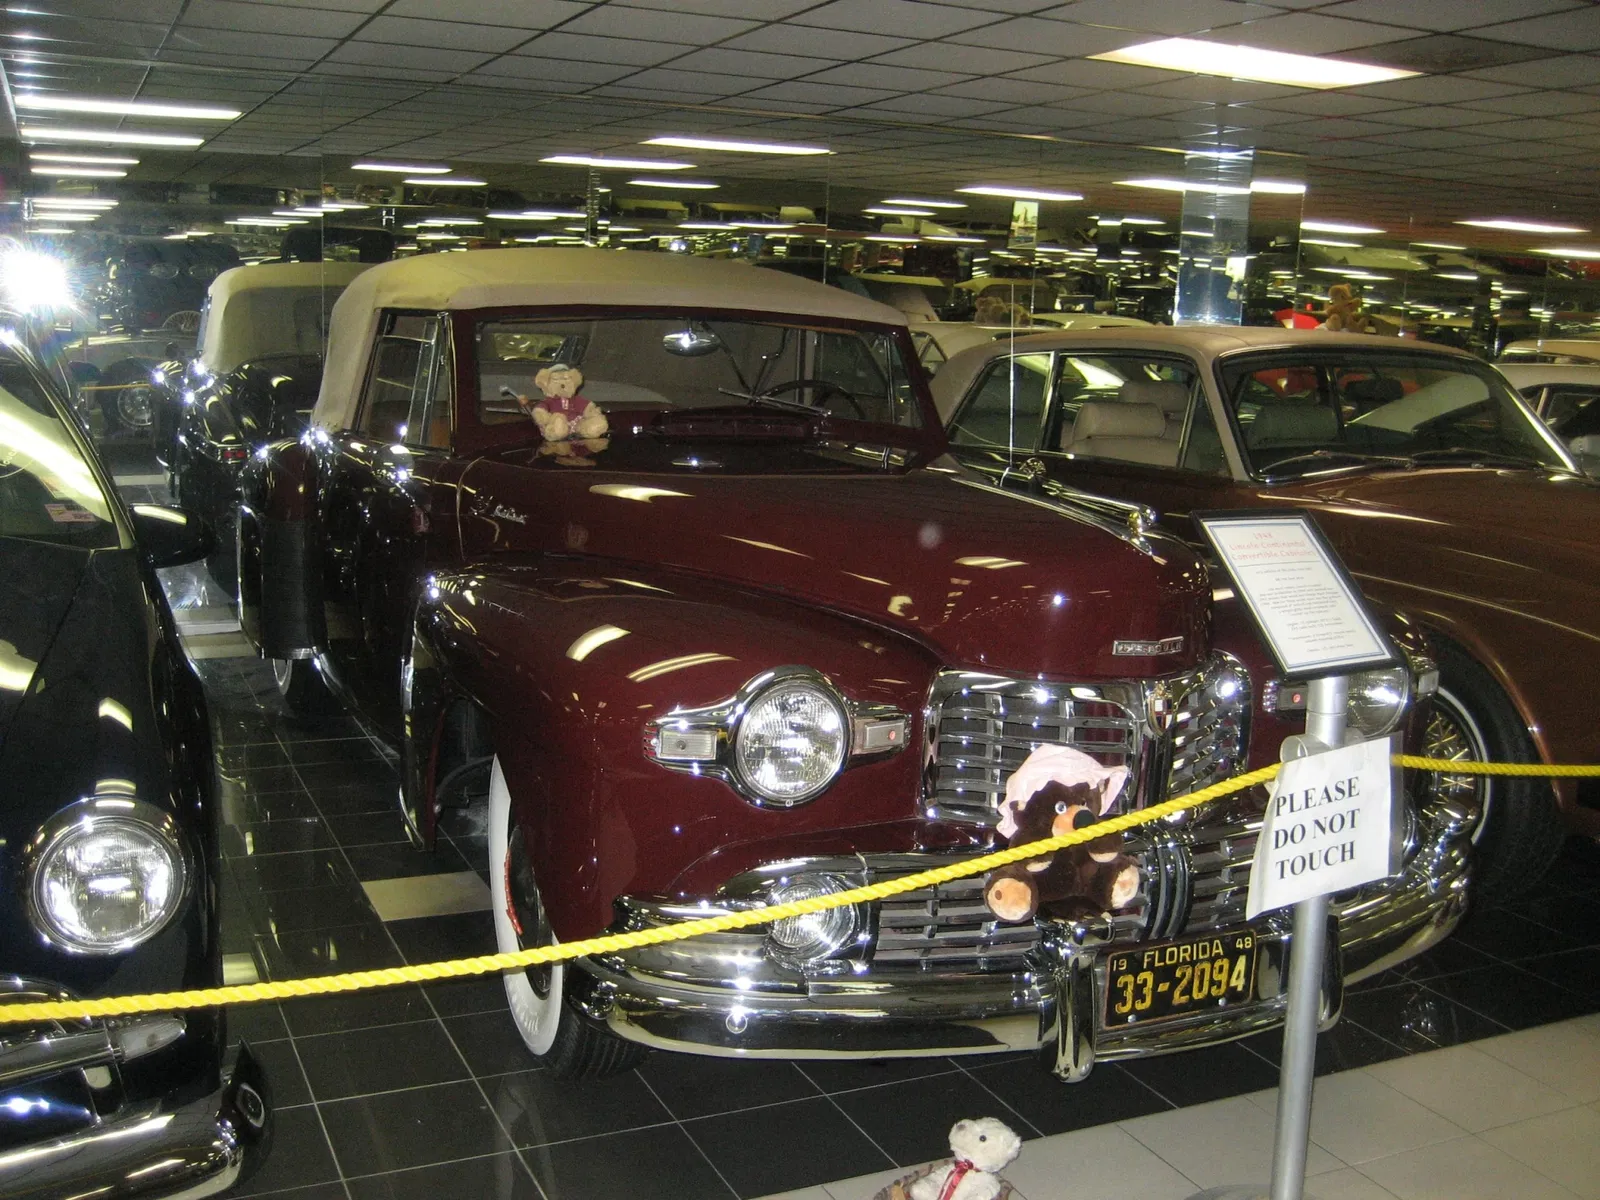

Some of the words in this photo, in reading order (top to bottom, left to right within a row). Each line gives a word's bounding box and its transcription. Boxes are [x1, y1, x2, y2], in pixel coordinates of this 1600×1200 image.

[1275, 776, 1360, 817] PLEASE
[1273, 823, 1306, 850] DO
[1312, 808, 1360, 839] NOT
[1275, 840, 1355, 880] TOUCH
[1113, 959, 1127, 971] 19
[1143, 939, 1223, 969] FLORIDA
[1235, 937, 1252, 949] 48
[1115, 955, 1247, 1014] 33-2094
